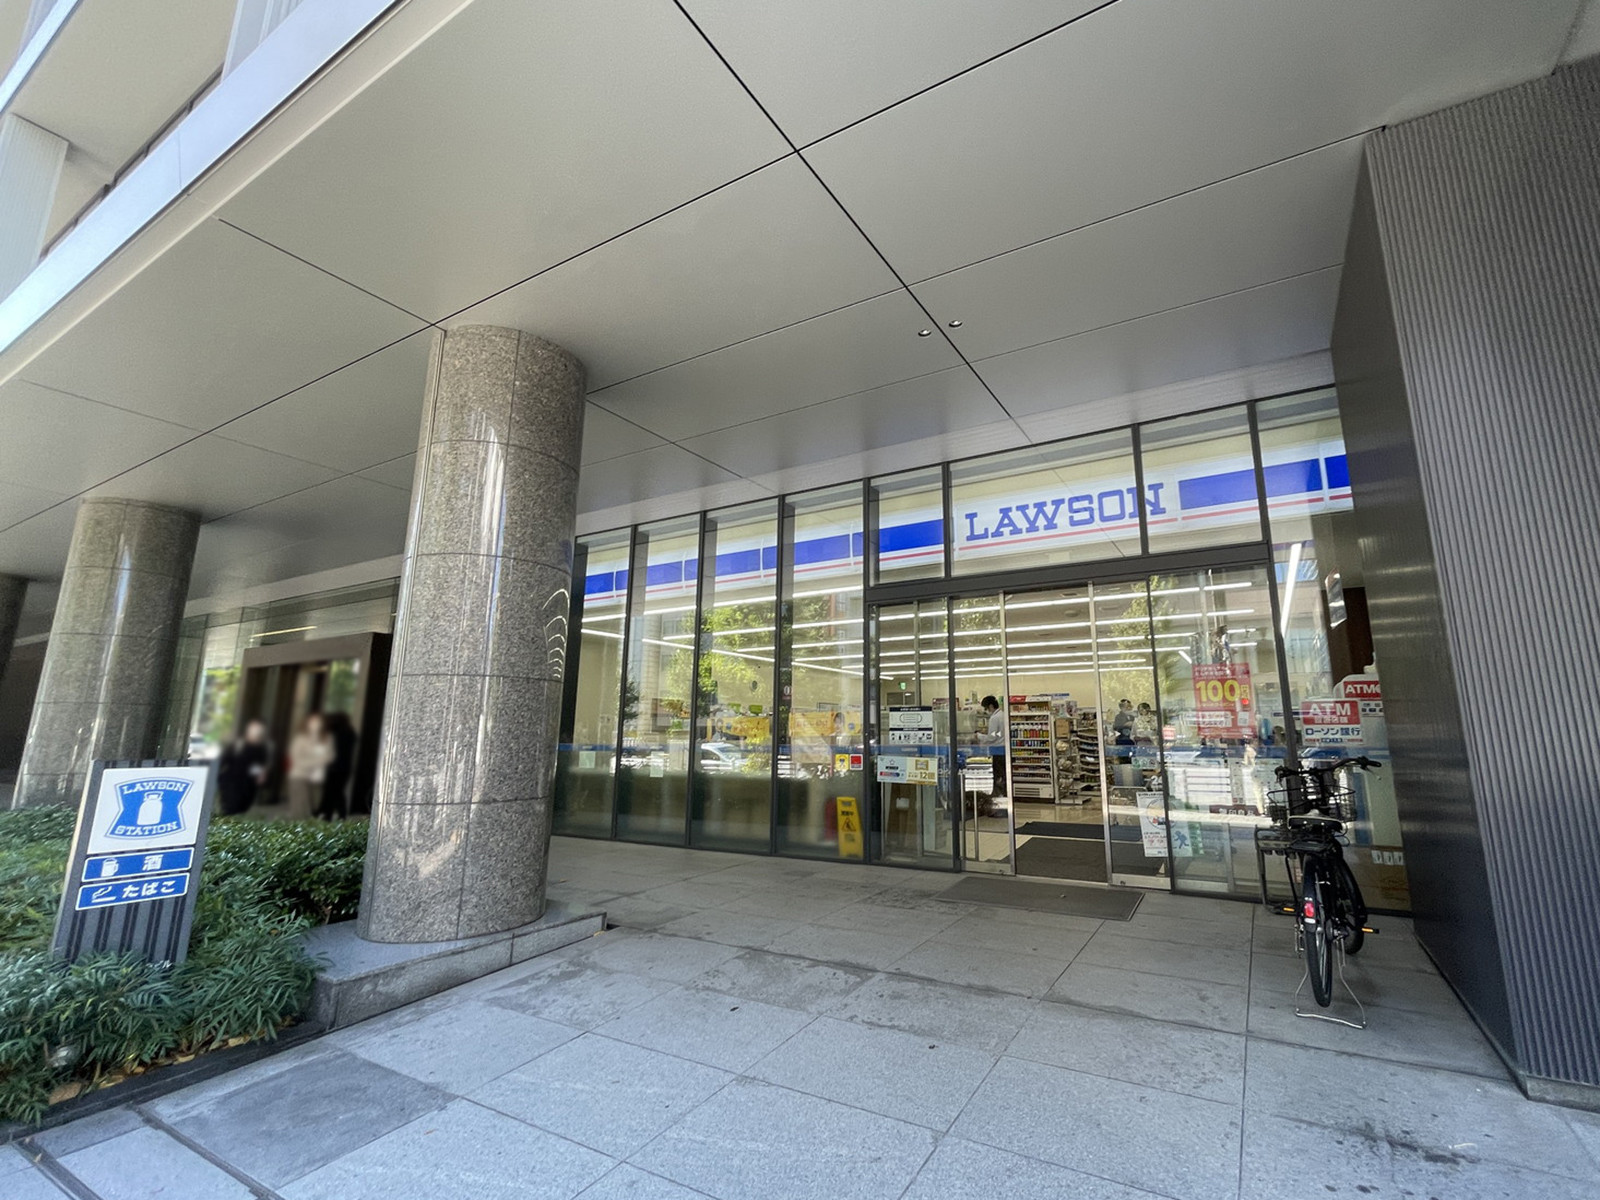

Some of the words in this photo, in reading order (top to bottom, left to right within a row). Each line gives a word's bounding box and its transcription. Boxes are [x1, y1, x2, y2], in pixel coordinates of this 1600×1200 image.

[964, 482, 1166, 542] LAWSON
[1309, 703, 1351, 716] ATM
[1305, 727, 1361, 736] ローソン銀行
[122, 781, 187, 795] LAWSON
[114, 821, 178, 836] STATION
[142, 854, 164, 871] 酒
[122, 880, 176, 898] たばこ
